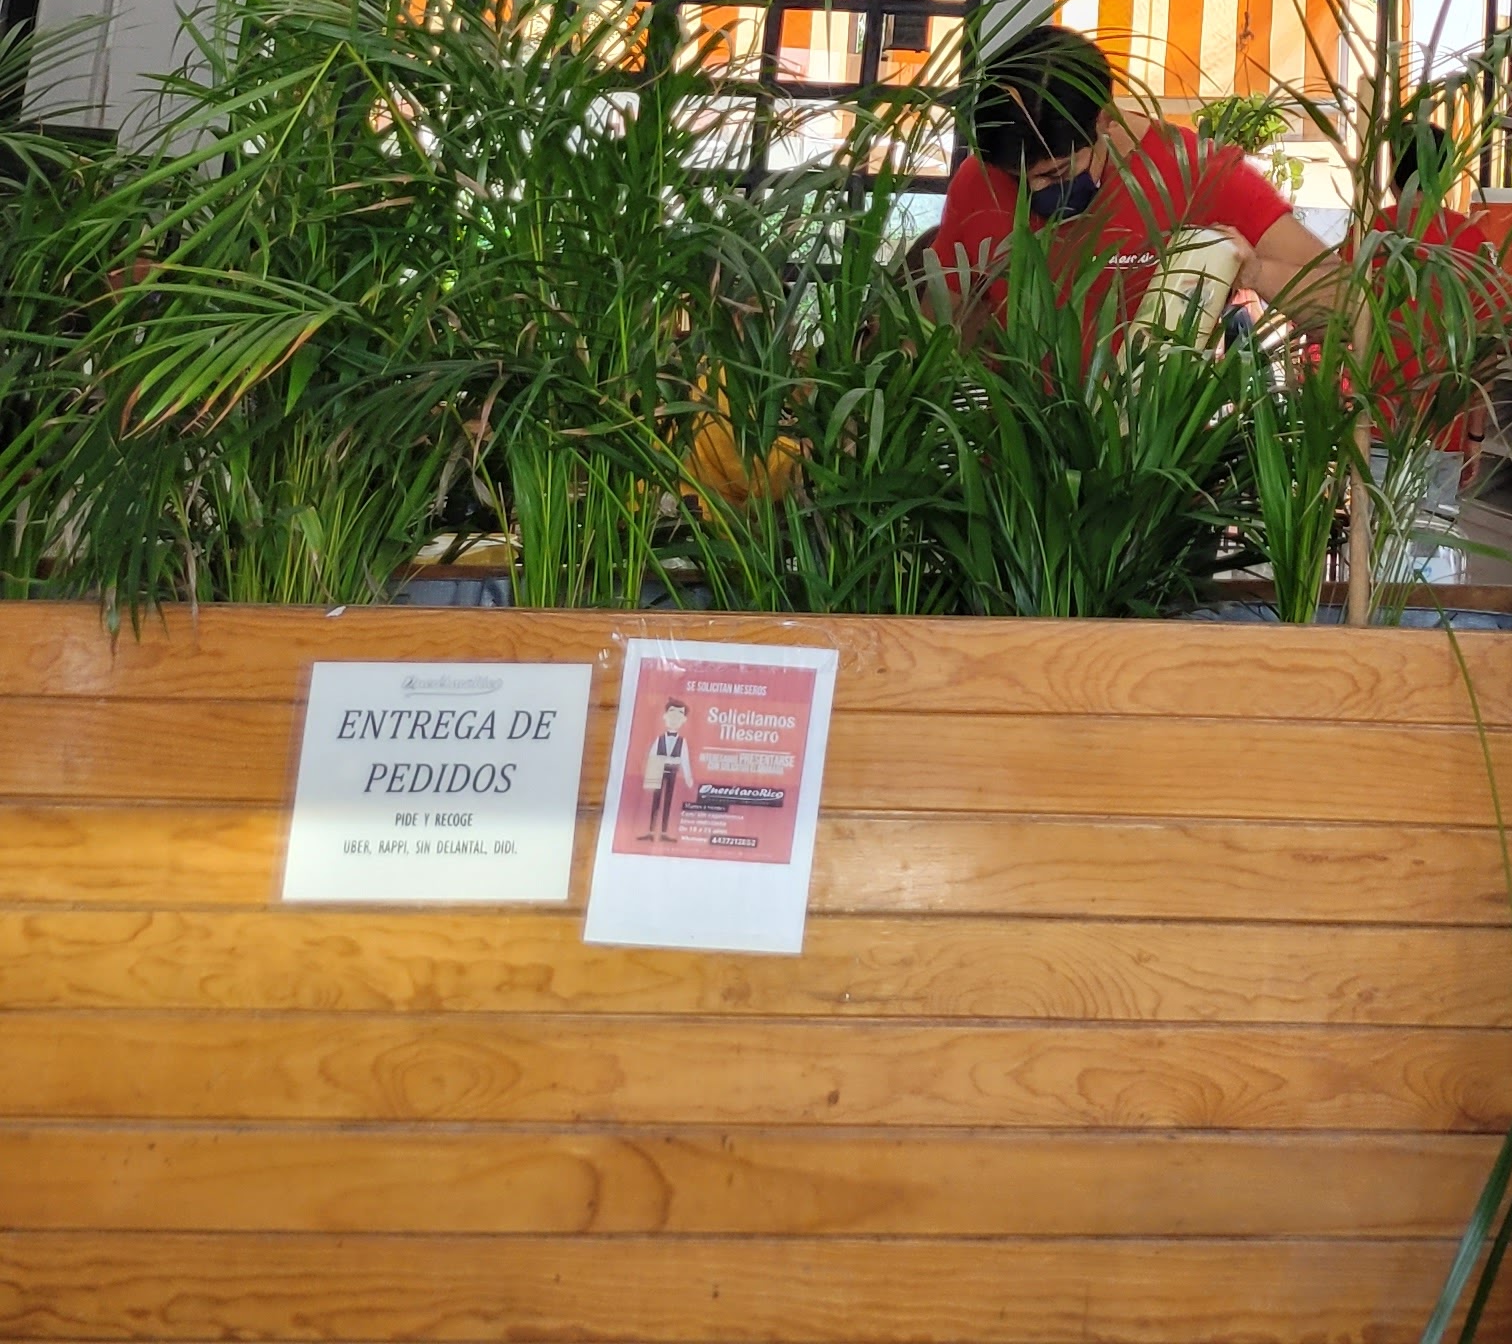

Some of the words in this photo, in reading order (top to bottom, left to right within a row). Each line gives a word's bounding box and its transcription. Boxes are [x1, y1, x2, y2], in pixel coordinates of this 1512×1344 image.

[686, 680, 697, 692] SE
[697, 681, 734, 694] SOLICITAN
[733, 683, 768, 696] MESEROS
[337, 710, 496, 740] ENTREGA
[506, 710, 557, 740] DE
[707, 707, 796, 729] Solicitamos
[720, 723, 779, 744] Mesero
[364, 763, 517, 793] PEDIDOS
[699, 784, 784, 800] QuerétaroRico
[395, 813, 418, 827] PIDE
[424, 813, 431, 827] Y
[435, 813, 473, 827] RECOGE
[343, 840, 372, 855] UBER,
[378, 840, 410, 855] RAPPI,
[416, 840, 430, 854] SIN
[436, 840, 488, 855] DELANTAL,
[493, 840, 518, 854] DIDI.
